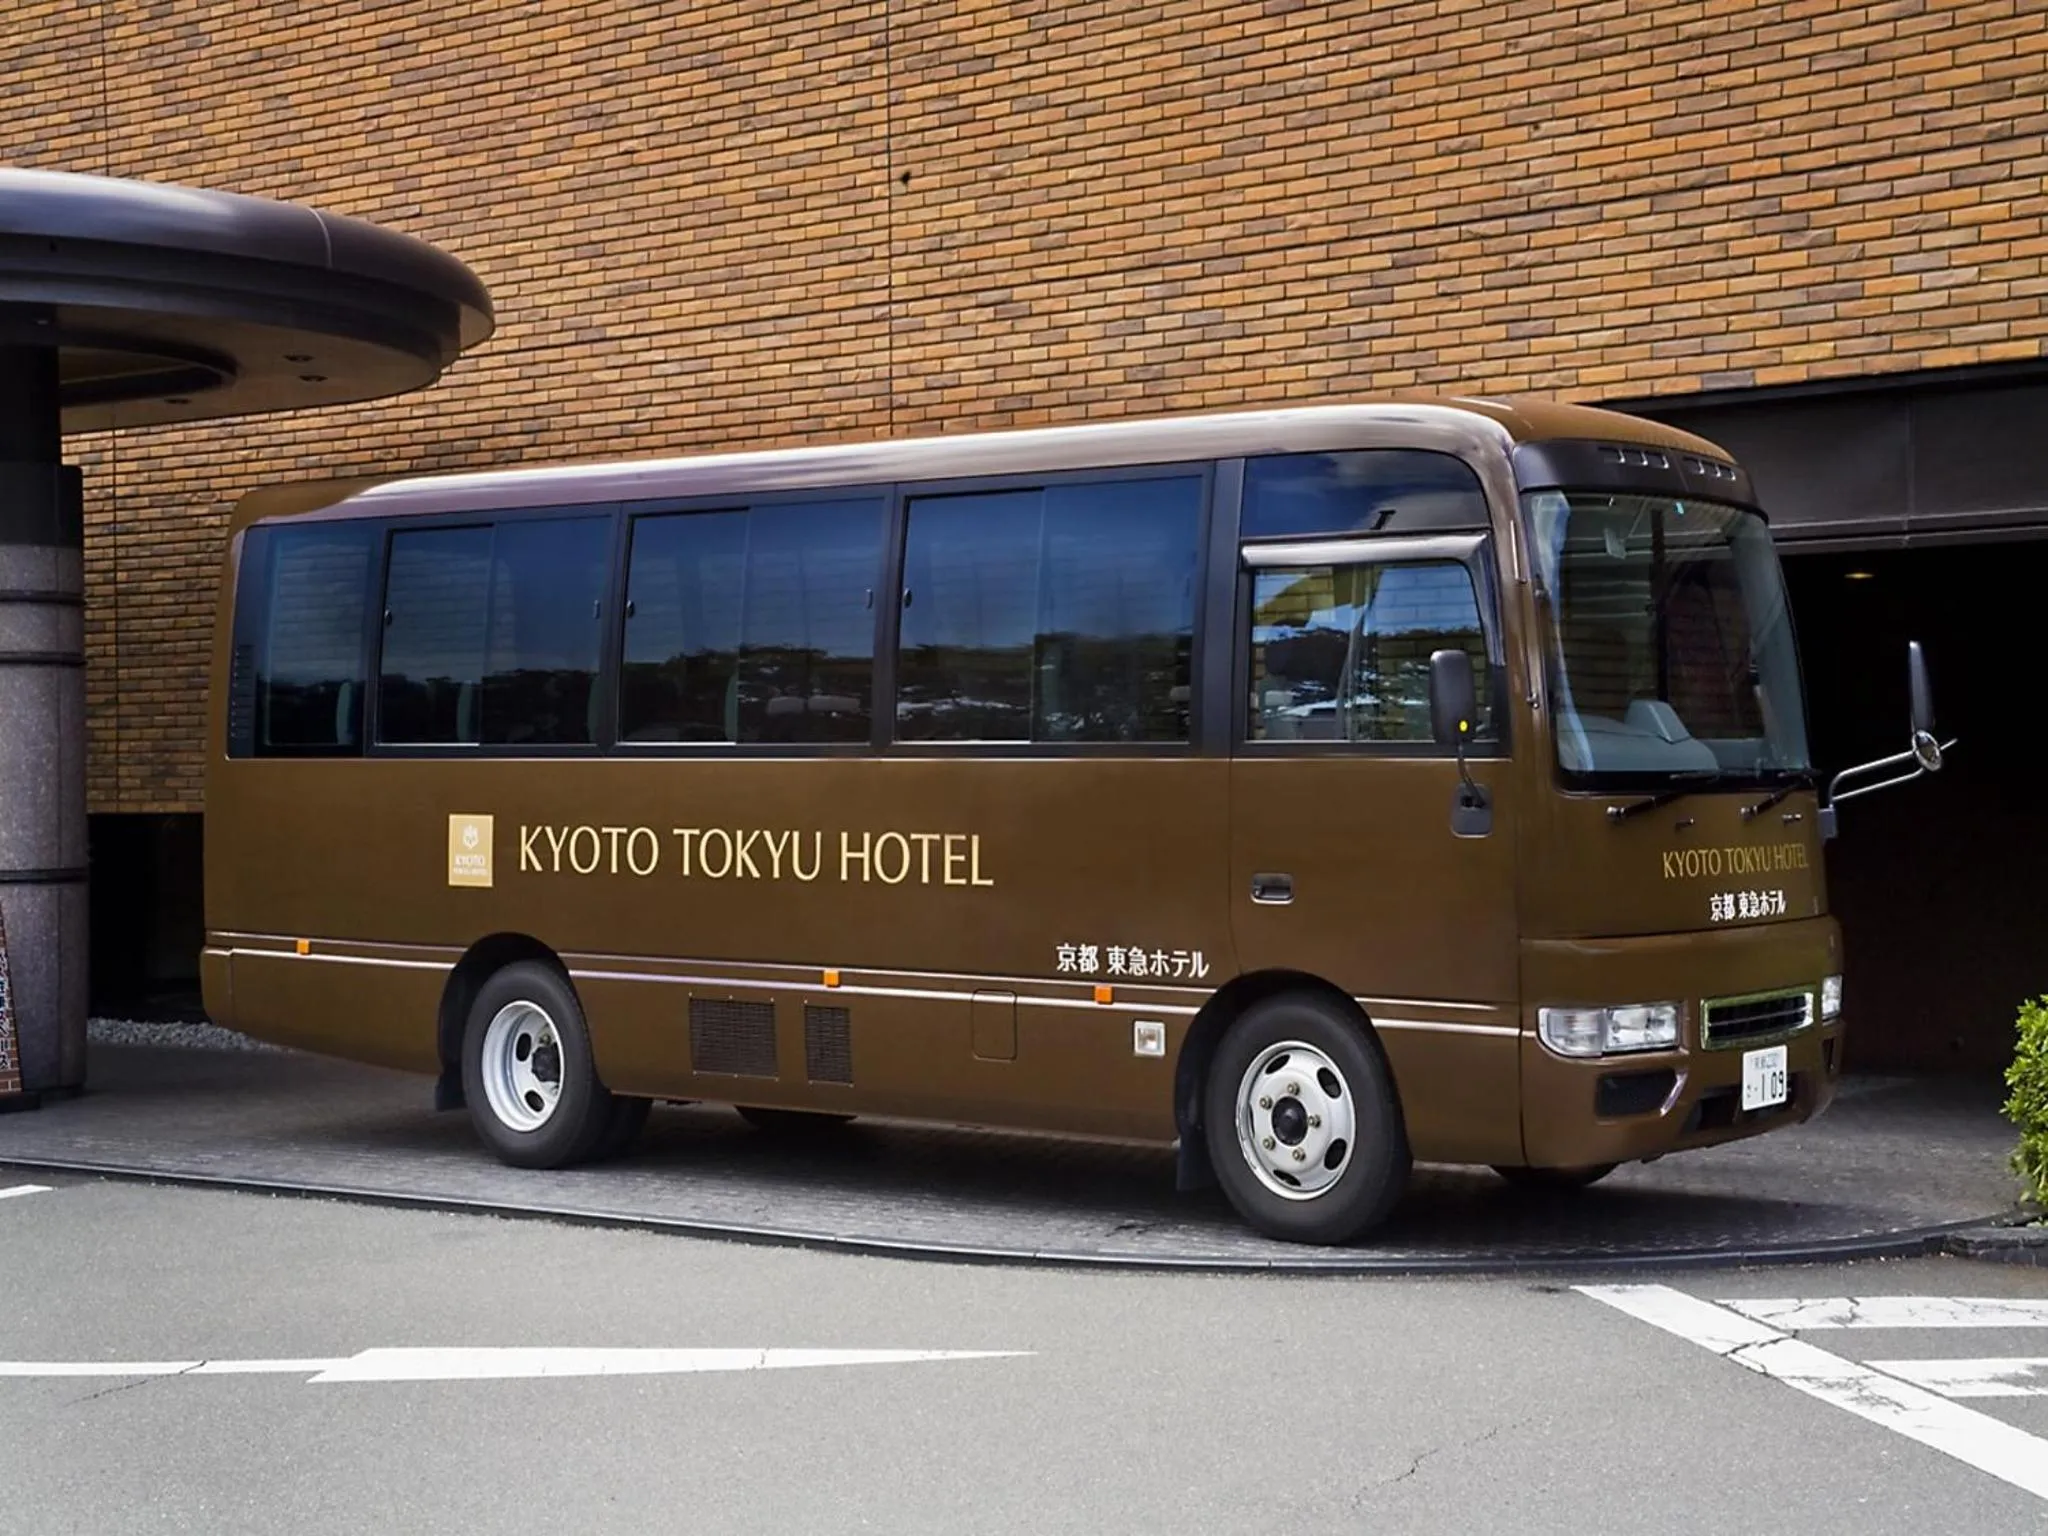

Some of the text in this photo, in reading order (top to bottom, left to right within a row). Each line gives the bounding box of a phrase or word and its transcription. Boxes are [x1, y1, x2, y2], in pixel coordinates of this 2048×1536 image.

[519, 824, 995, 886] KYOTO TOKYU HOTEL
[1662, 843, 1809, 879] KYOTO TOKYU HOTEL
[1709, 889, 1786, 922] 京都 東急ホテル
[1056, 942, 1210, 979] 京都 東急ホテル
